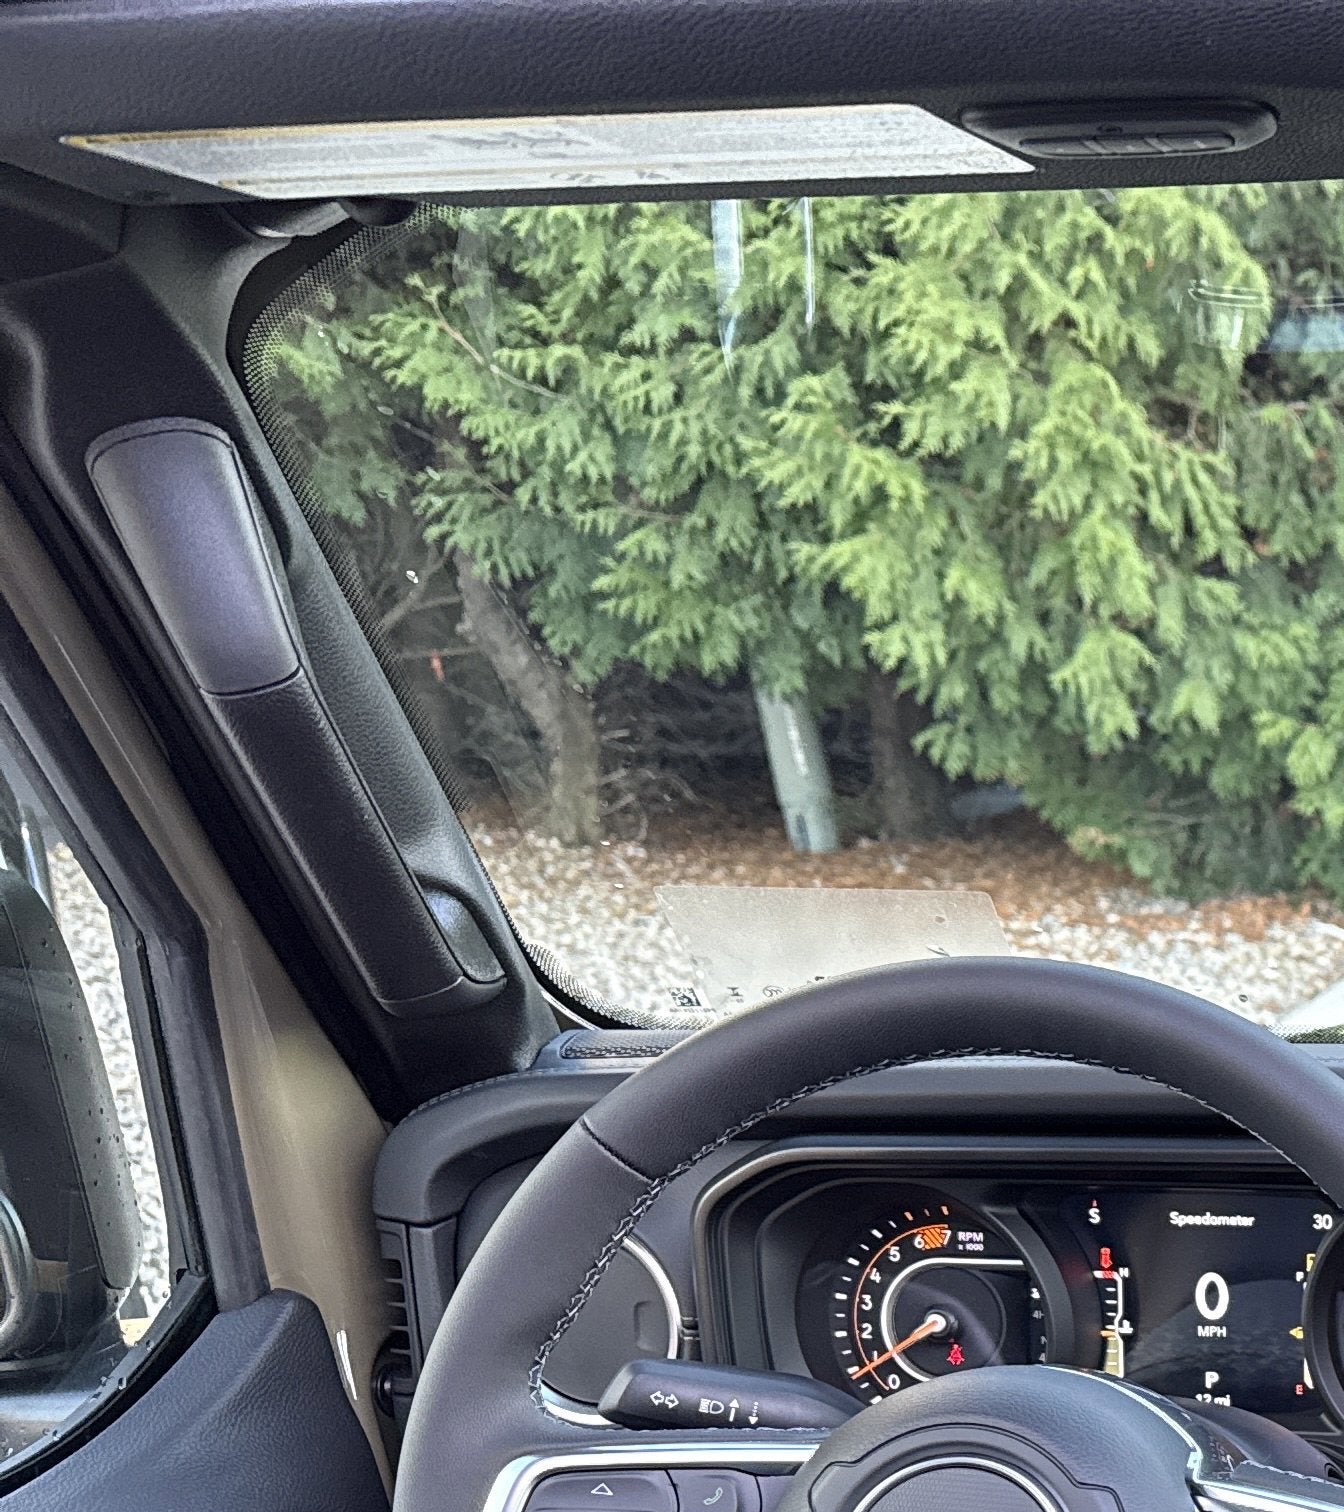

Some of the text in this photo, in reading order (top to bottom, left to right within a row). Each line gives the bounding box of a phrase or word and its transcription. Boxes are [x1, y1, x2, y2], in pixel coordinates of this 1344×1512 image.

[1088, 1208, 1101, 1225] S
[1170, 1211, 1256, 1227] Speedometer
[1312, 1214, 1333, 1230] 30
[914, 1236, 925, 1249] 6
[941, 1230, 951, 1246] 7
[957, 1232, 984, 1242] RPM
[889, 1247, 900, 1262] 5
[870, 1268, 882, 1283] 4
[1119, 1268, 1129, 1278] H
[861, 1295, 873, 1310] 3
[1195, 1271, 1230, 1320] 0
[861, 1323, 873, 1339] 2
[1197, 1326, 1227, 1338] MPH
[888, 1375, 900, 1389] 0
[1205, 1372, 1220, 1389] P
[1296, 1385, 1303, 1395] E
